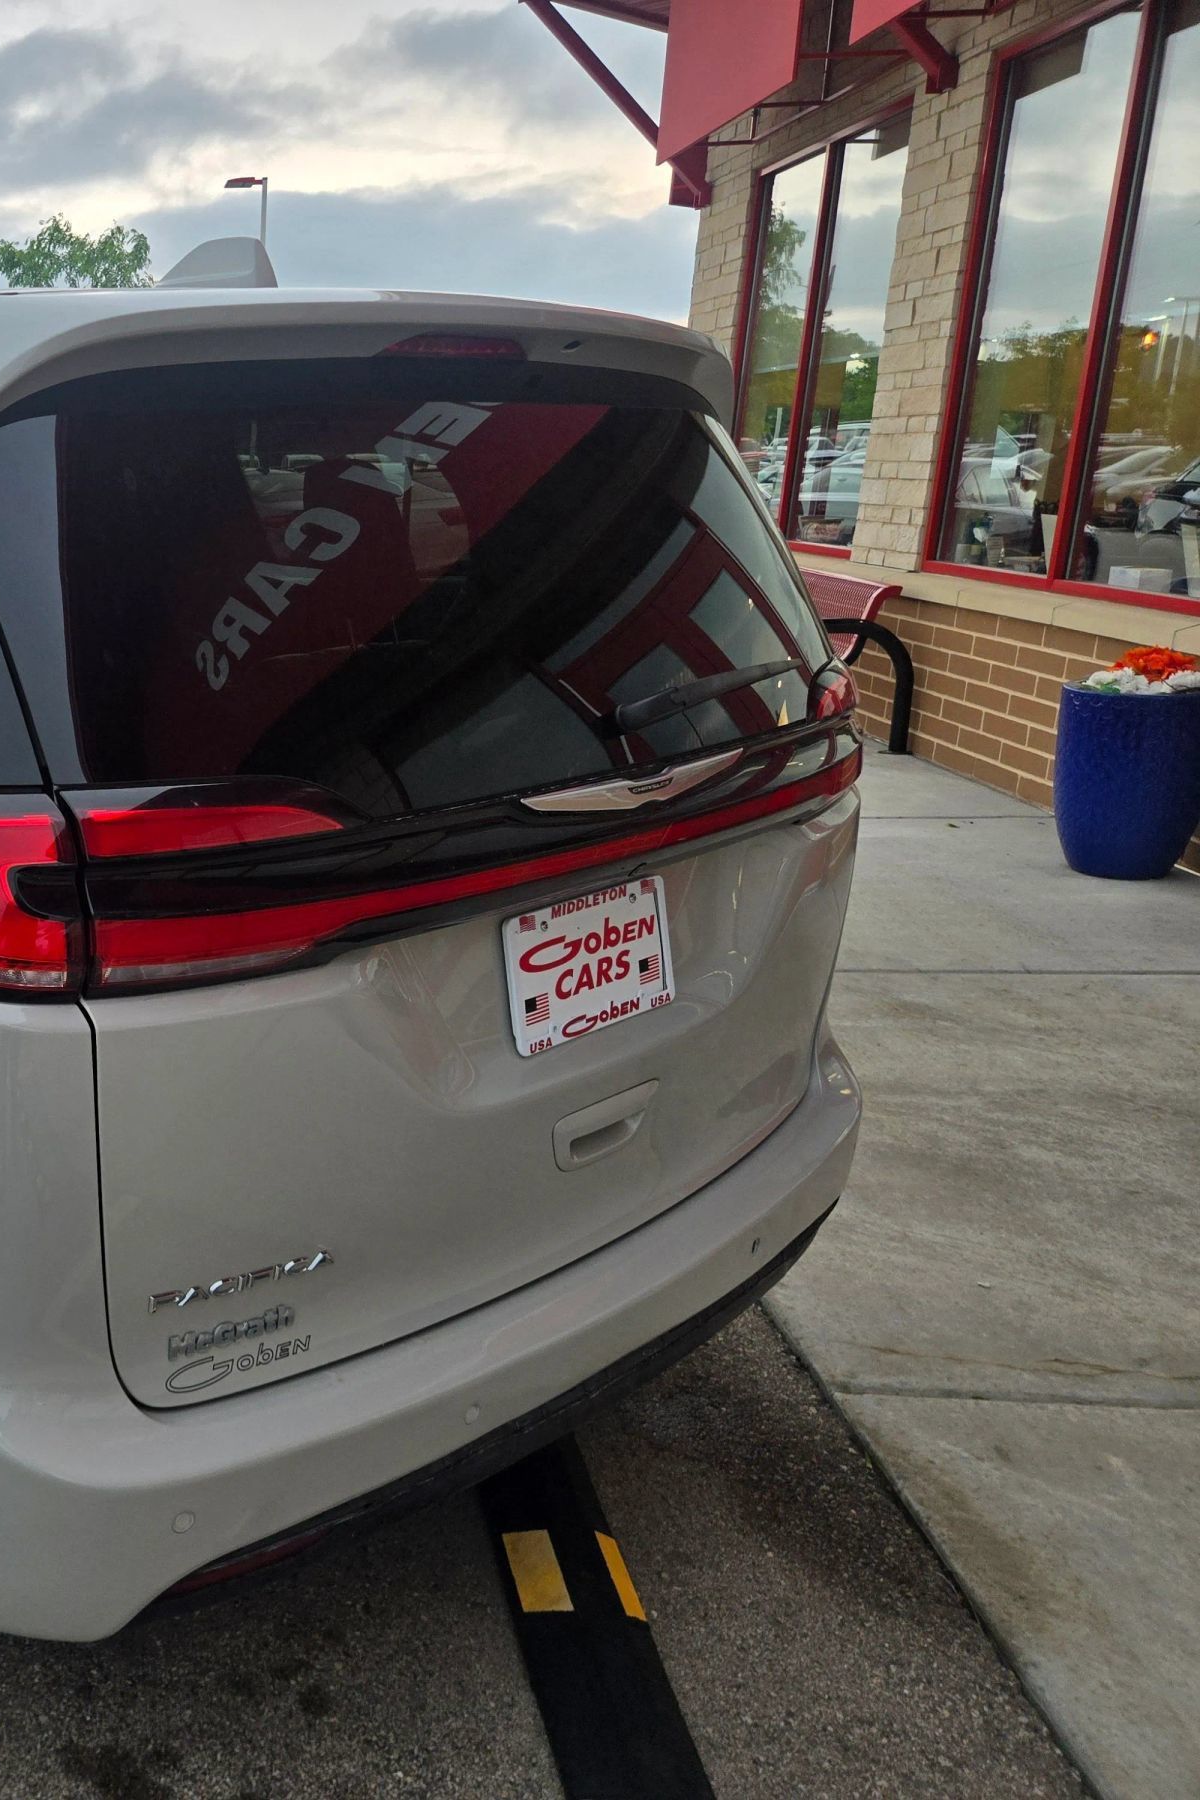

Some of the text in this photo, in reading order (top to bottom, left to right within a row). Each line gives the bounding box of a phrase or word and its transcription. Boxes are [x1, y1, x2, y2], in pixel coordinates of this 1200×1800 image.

[551, 885, 627, 919] MIDDLETON
[555, 950, 630, 1000] CARS
[650, 992, 671, 1008] USA
[529, 1037, 553, 1054] USA
[148, 1246, 334, 1314] PACIFICA
[167, 1304, 295, 1362] McGrath
